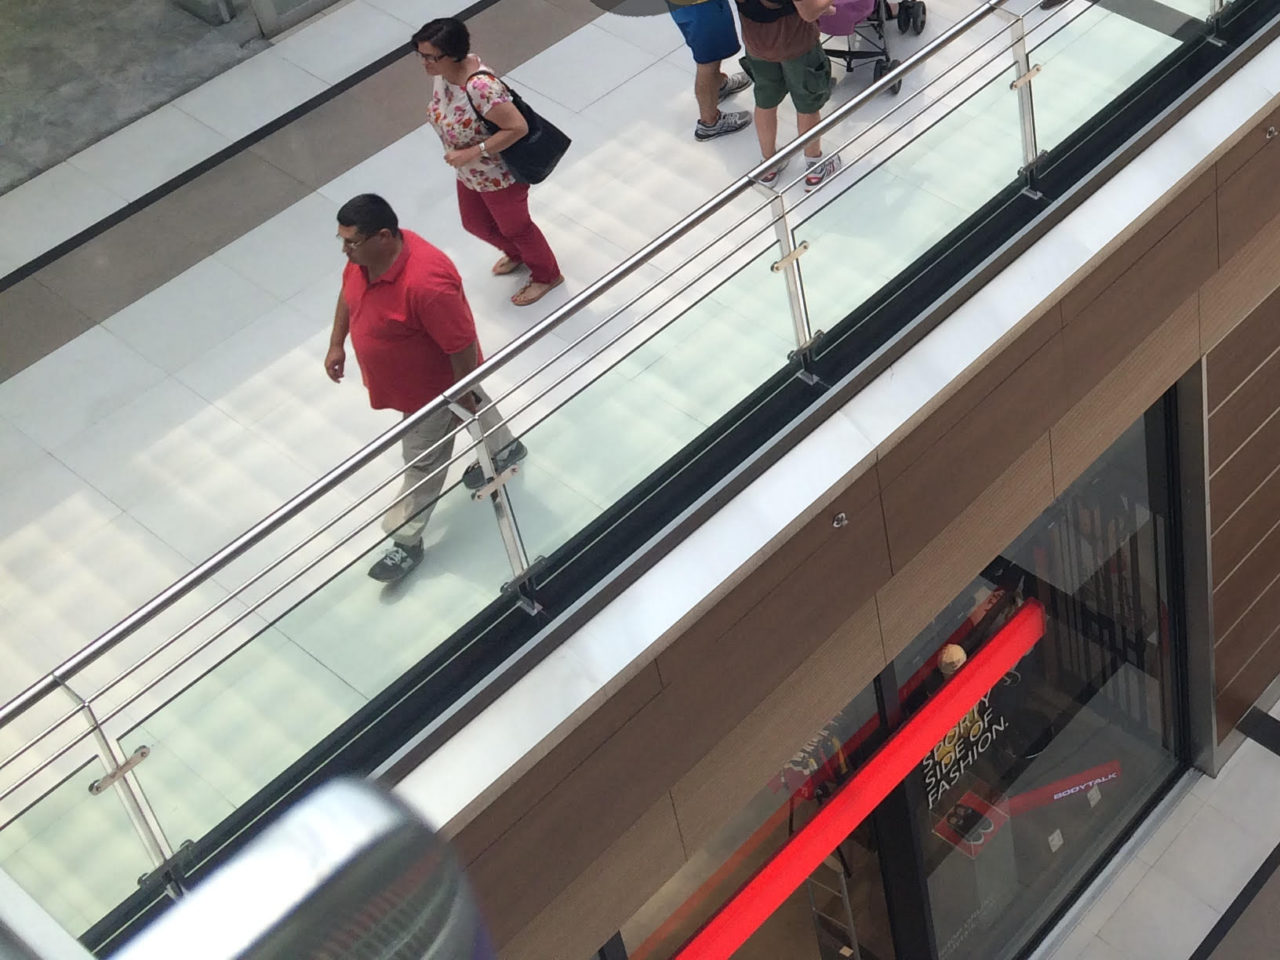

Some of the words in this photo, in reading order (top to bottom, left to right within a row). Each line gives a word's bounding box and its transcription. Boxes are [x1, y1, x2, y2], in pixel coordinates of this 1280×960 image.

[925, 737, 966, 792] SIDE
[969, 707, 993, 742] OF
[928, 716, 1010, 810] FASHION.
[1053, 772, 1118, 800] BODYTALK
